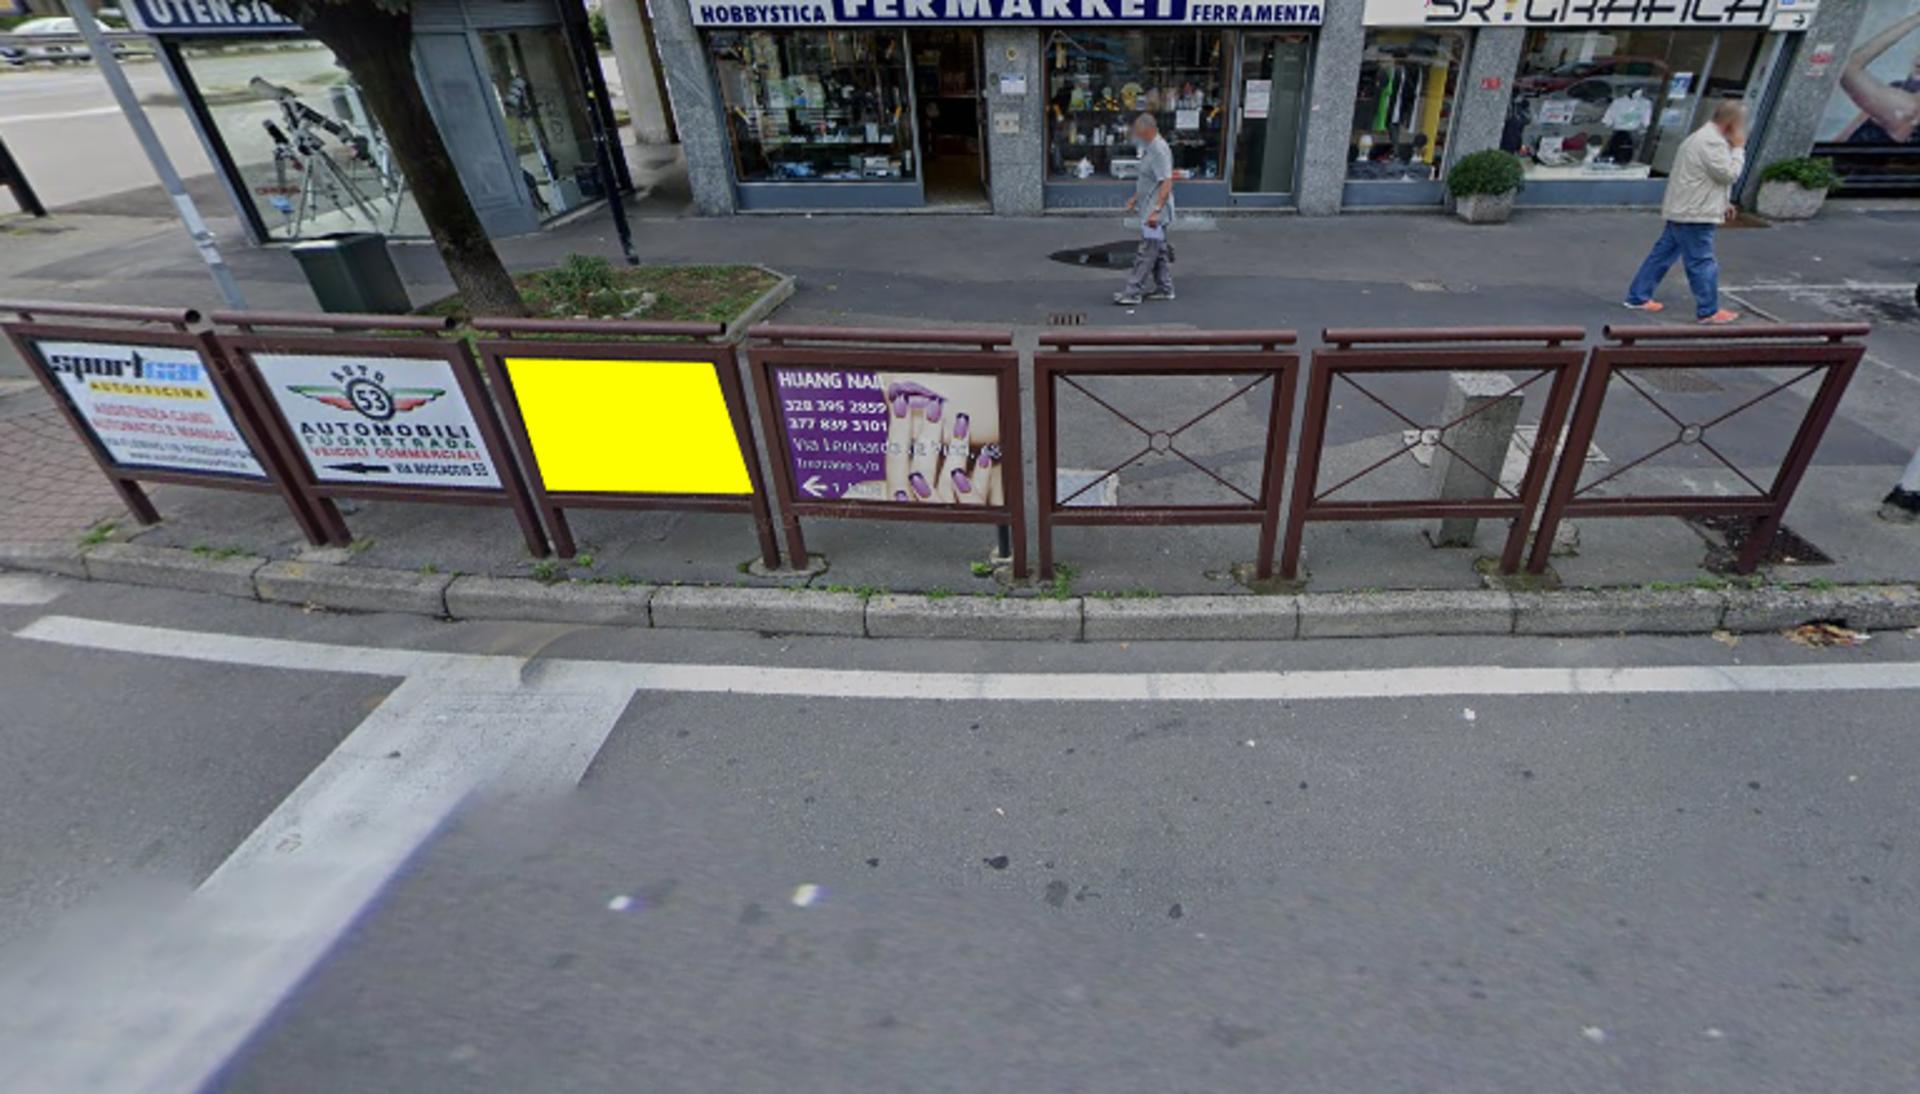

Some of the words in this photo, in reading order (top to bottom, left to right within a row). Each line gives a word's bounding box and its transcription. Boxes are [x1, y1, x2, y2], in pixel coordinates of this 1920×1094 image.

[701, 5, 827, 23] HOBBYSTICA
[1190, 4, 1321, 22] FERRAMENTA
[330, 364, 387, 385] AUTO
[777, 371, 843, 389] HUANG
[90, 381, 208, 399] AUTOFFICINA
[355, 389, 388, 412] 53
[300, 422, 472, 438] AUTOMOBILI
[304, 435, 477, 449] FUORISTRADA
[311, 447, 369, 458] VEICOLI
[374, 448, 482, 460] COMMERCIALI
[393, 462, 413, 474] VIA
